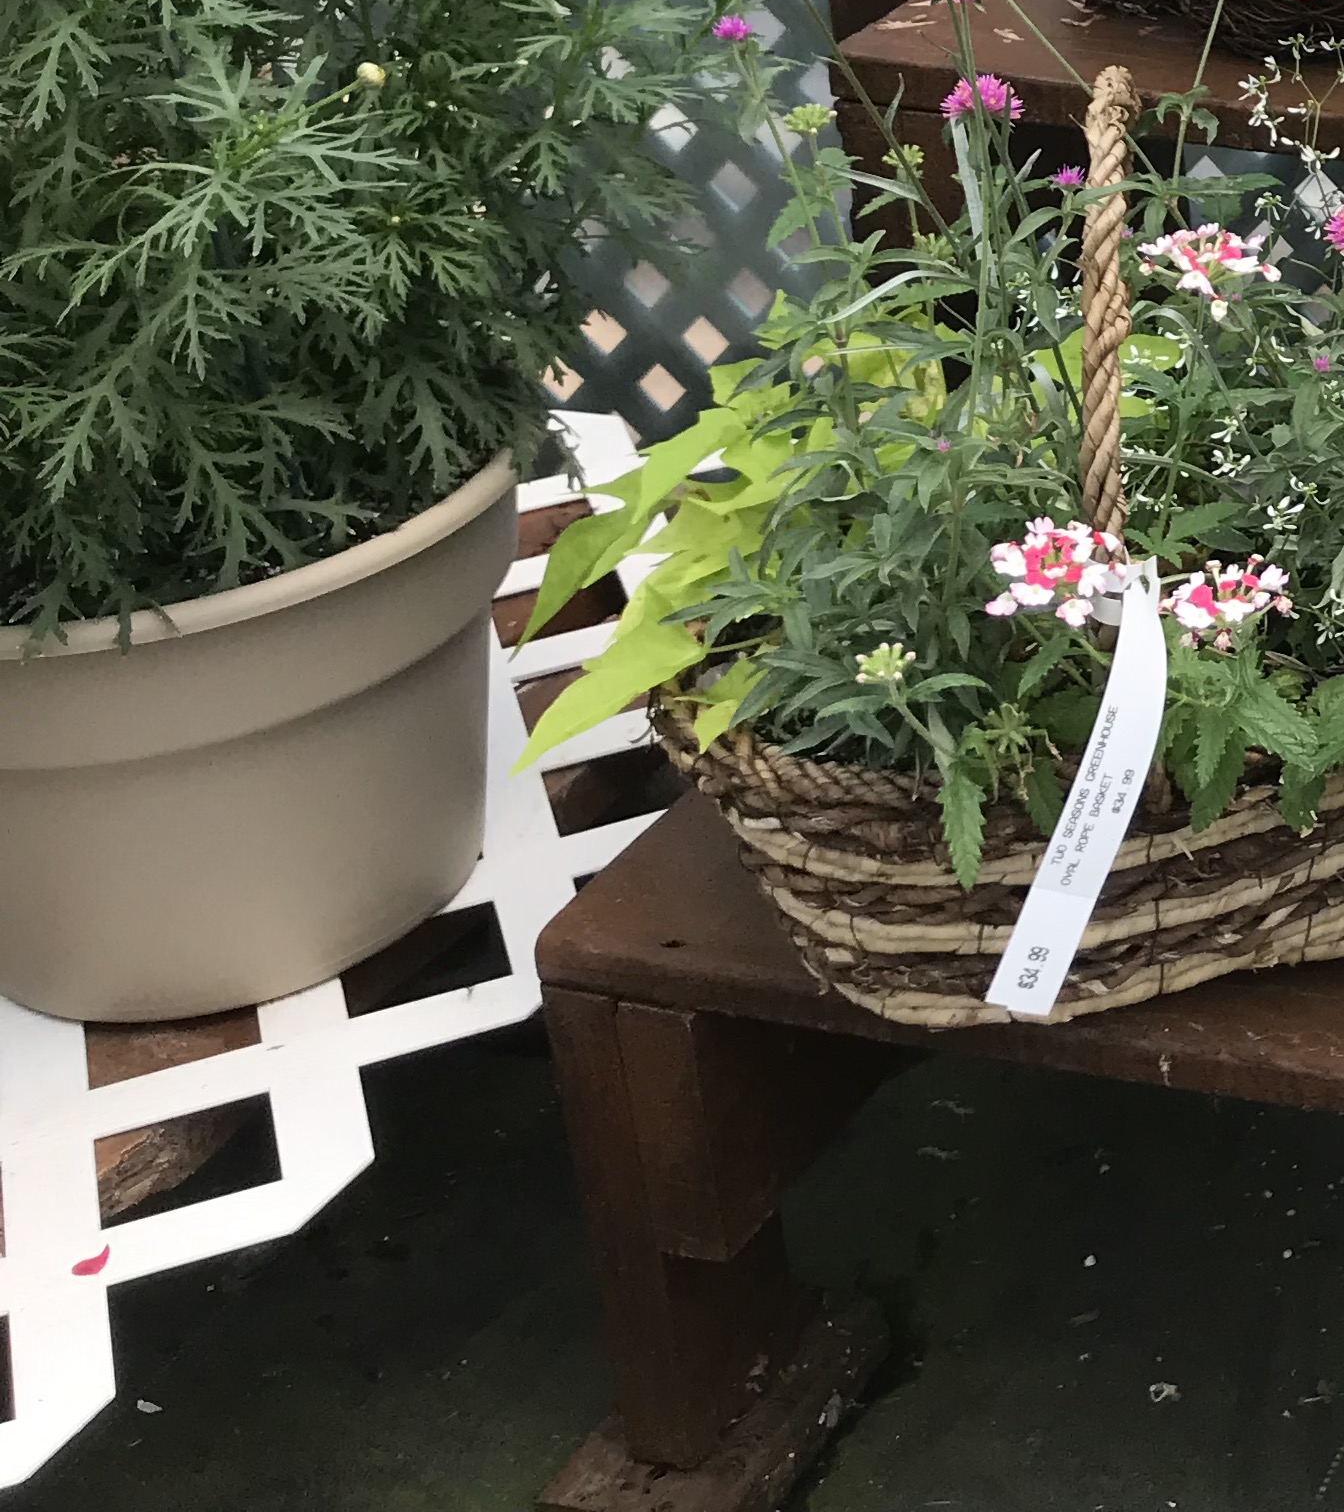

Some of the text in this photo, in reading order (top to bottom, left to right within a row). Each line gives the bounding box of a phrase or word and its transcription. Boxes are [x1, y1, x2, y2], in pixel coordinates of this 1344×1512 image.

[1050, 705, 1119, 865] TWO SEASONS GREENHOUSE
[1060, 772, 1114, 886] OVAL ROPE BASKET
[1017, 946, 1050, 989] $34.99
